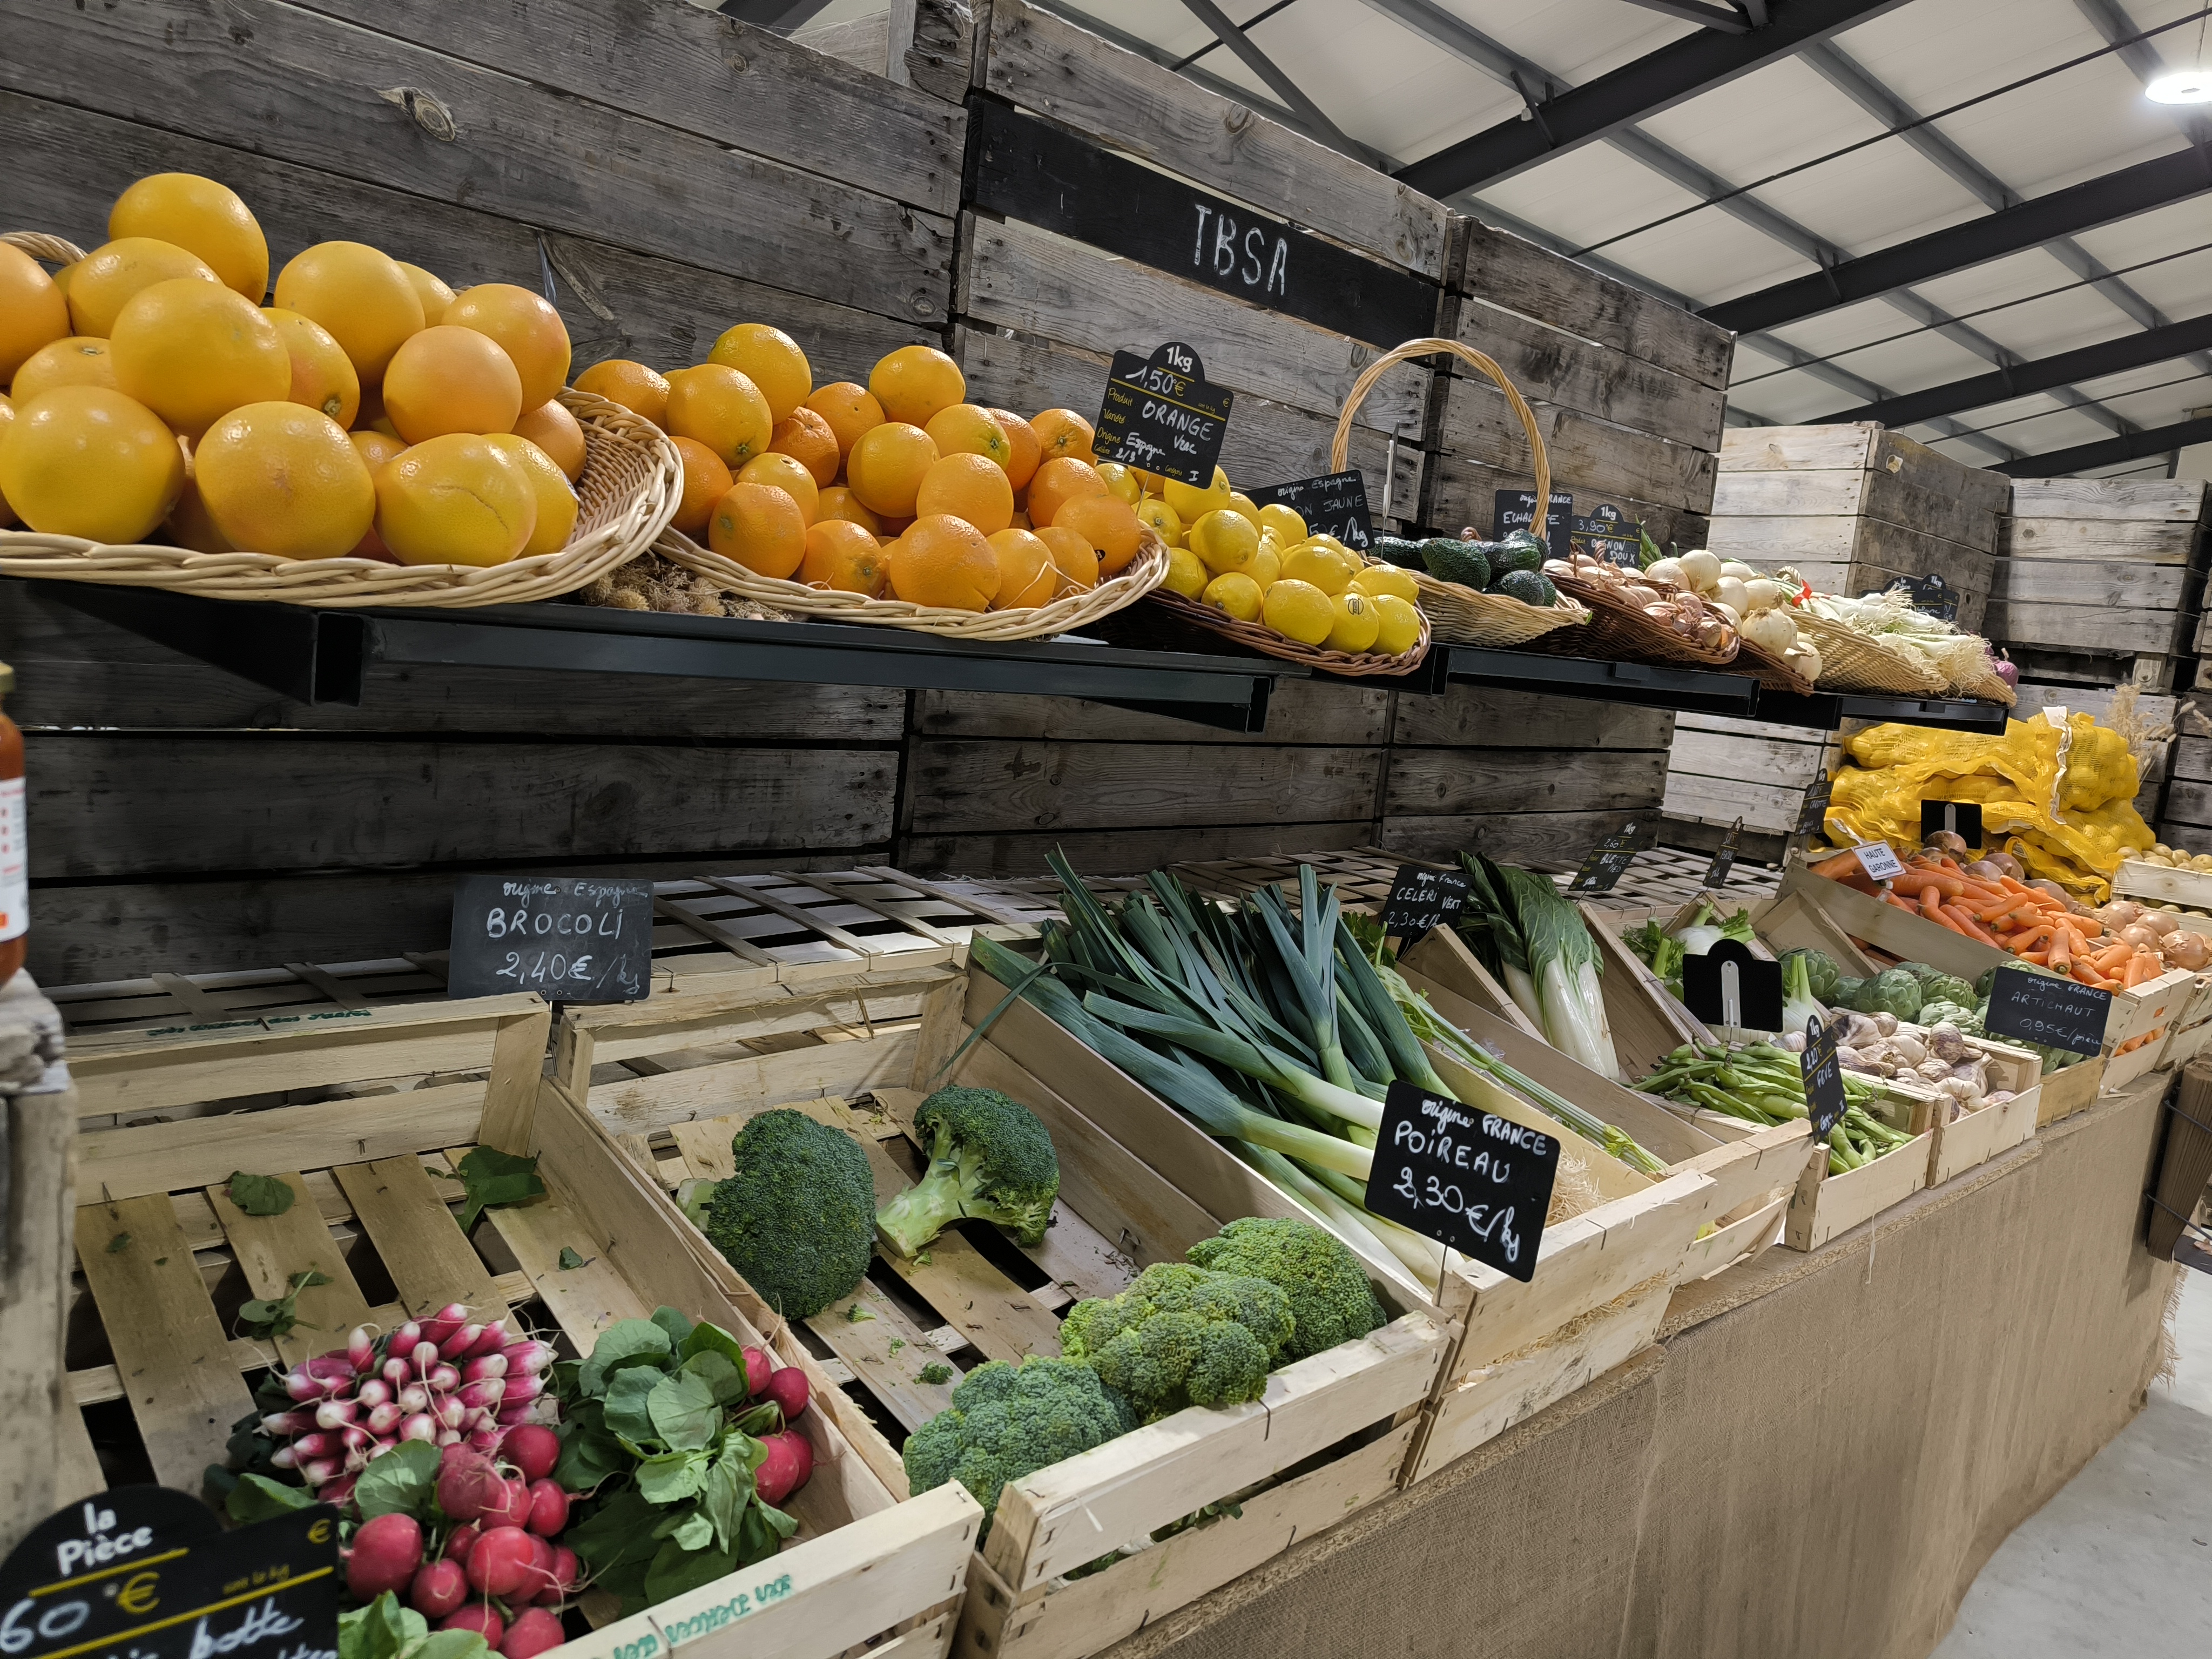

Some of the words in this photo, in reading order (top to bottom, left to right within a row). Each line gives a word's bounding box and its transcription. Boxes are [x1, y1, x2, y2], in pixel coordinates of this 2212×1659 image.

[1194, 203, 1287, 296] TBSA
[1166, 346, 1193, 373] 1kg
[1108, 387, 1133, 407] Produit
[1142, 400, 1214, 441] ORANGE
[1097, 427, 1121, 444] Origine
[1126, 432, 1165, 460] Espagne
[1174, 434, 1197, 455] Vrac
[1311, 476, 1356, 492] Espagne
[1323, 494, 1364, 512] JAUNE
[1548, 494, 1572, 504] RANCE
[1601, 506, 1616, 521] 1kg
[1610, 550, 1635, 565] DOUX
[1931, 576, 1943, 588] 1kg
[1624, 822, 1636, 834] 1kg
[1600, 853, 1630, 865] BLETTE
[1863, 848, 1886, 860] HAUTE
[1868, 859, 1899, 873] GARONNE
[1439, 874, 1467, 888] France
[1441, 895, 1461, 909] VERT
[2027, 977, 2062, 991] origine
[2068, 984, 2107, 1000] FRANCE
[1809, 1018, 1820, 1037] 1kg
[1421, 1098, 1471, 1134] origine
[1482, 1114, 1547, 1155] FRANCE
[84, 1502, 116, 1534] la
[307, 1518, 331, 1545] €
[57, 1526, 153, 1576] Pièce
